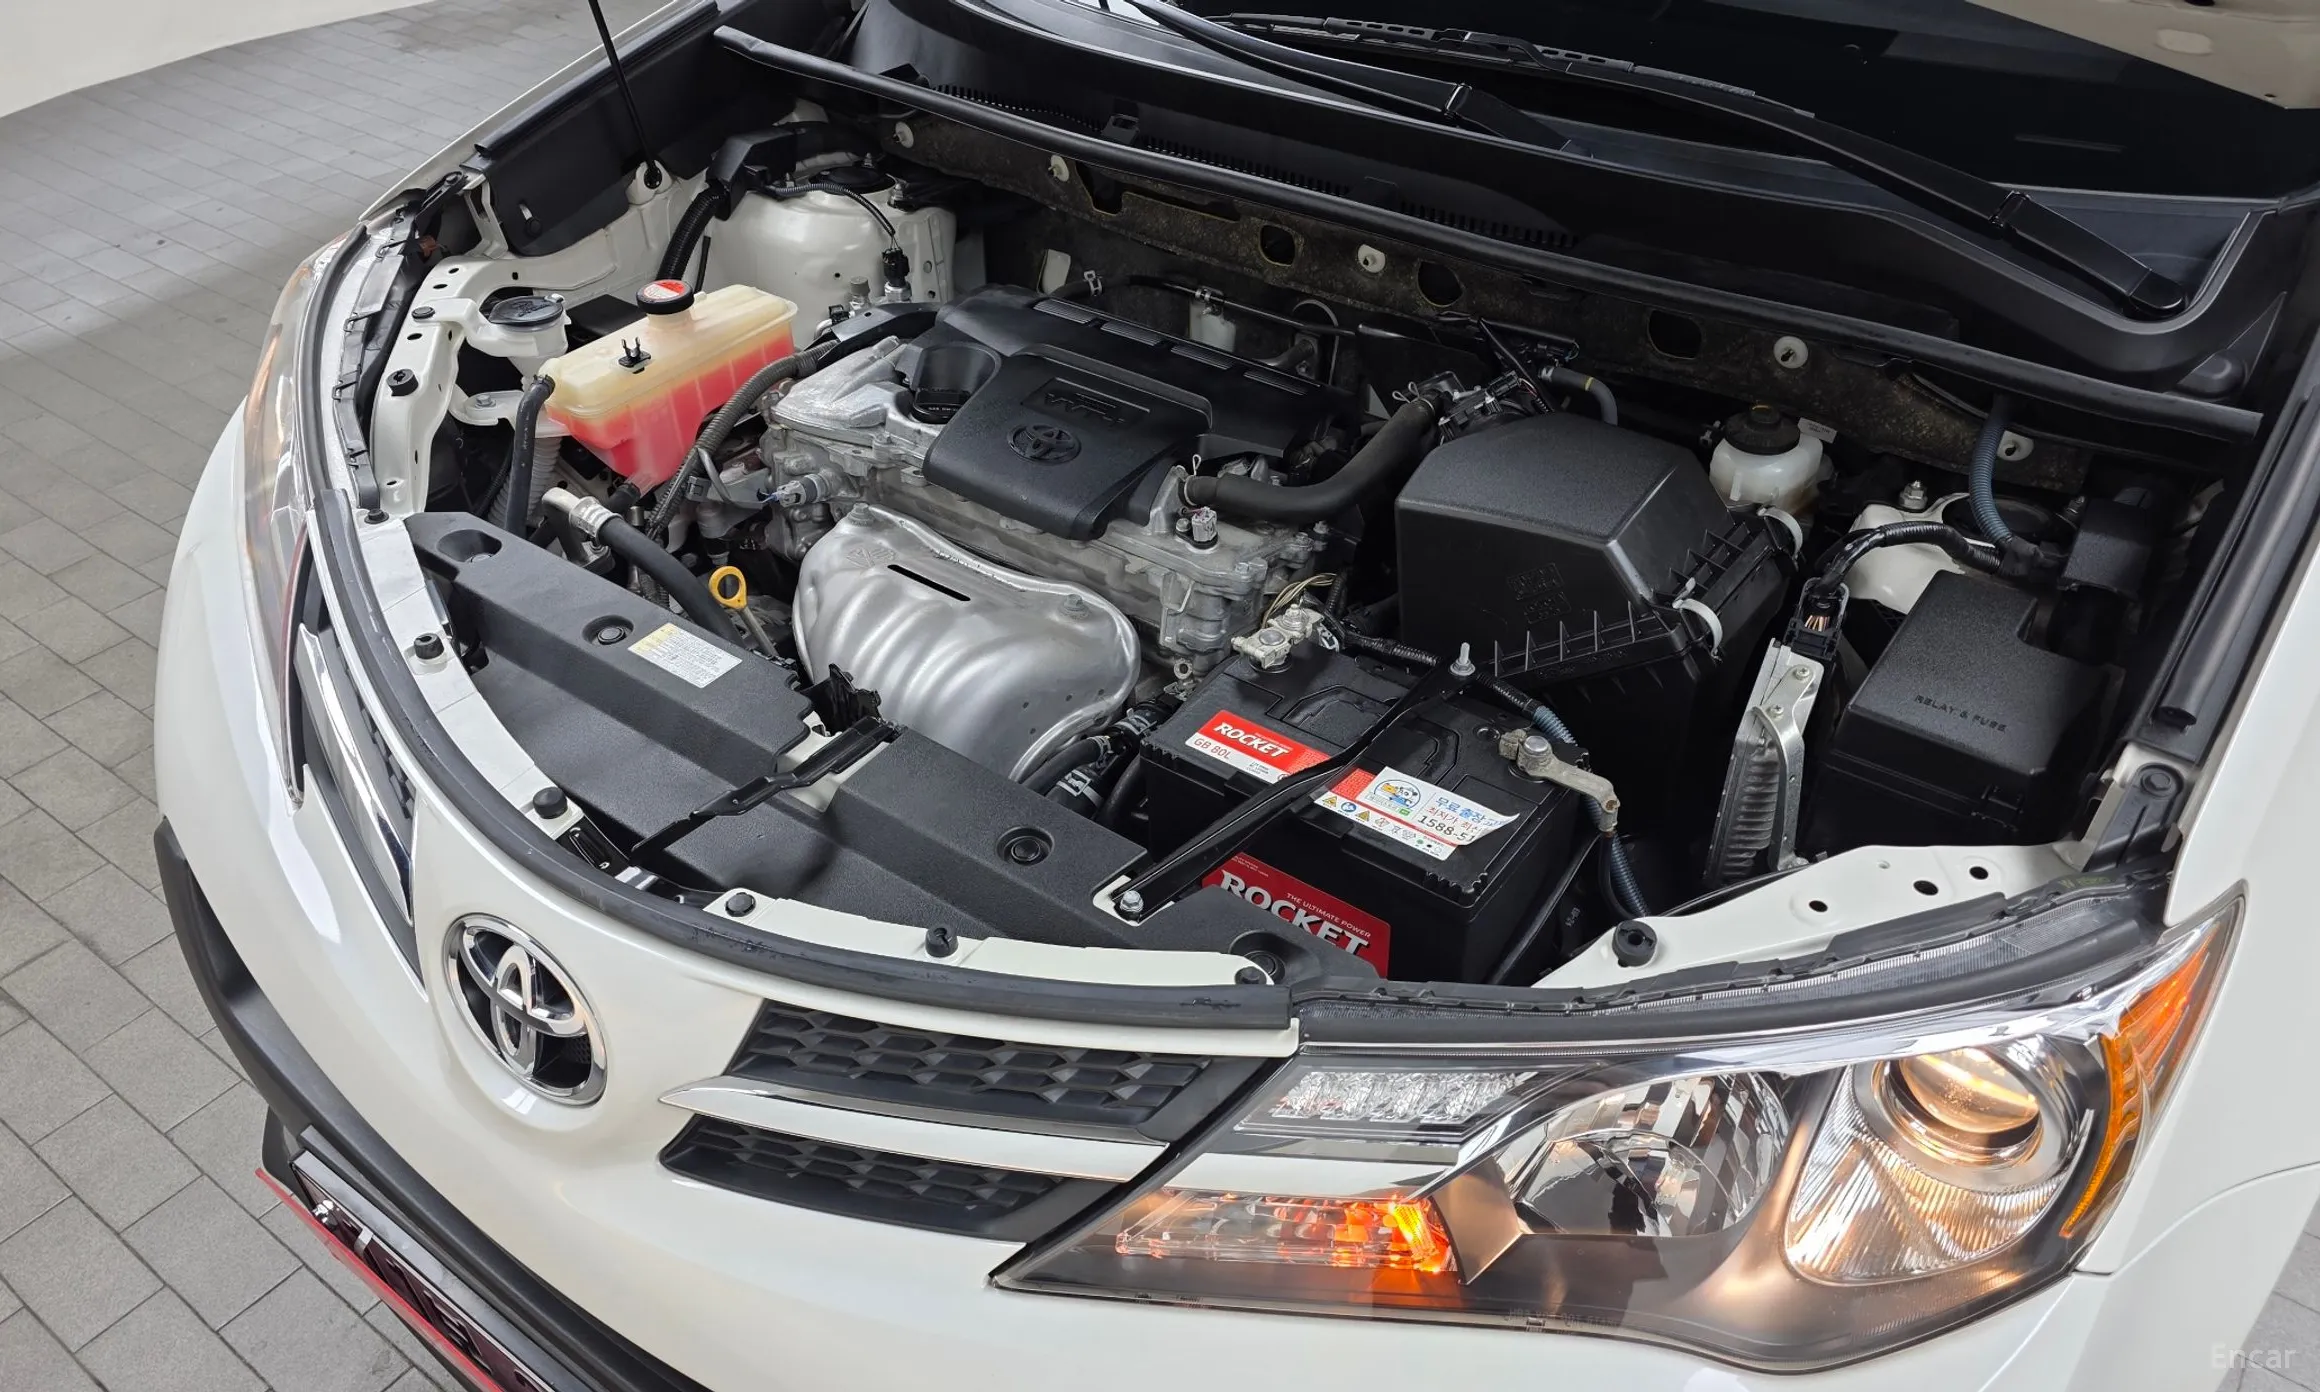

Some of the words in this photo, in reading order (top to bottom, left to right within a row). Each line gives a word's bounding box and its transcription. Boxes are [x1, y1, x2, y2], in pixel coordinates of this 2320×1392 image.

[1914, 694, 1955, 714] RELAY
[1959, 710, 1969, 719] &
[1971, 714, 2007, 732] FUSE
[1193, 738, 1212, 749] GB
[1210, 745, 1232, 759] 80L
[1213, 722, 1291, 757] ROCKET
[1436, 797, 1461, 813] 무료
[1220, 869, 1371, 955] ROCKET
[1286, 892, 1303, 904] THE
[1302, 900, 1341, 923] ULTIMATE
[1340, 920, 1372, 939] POWER
